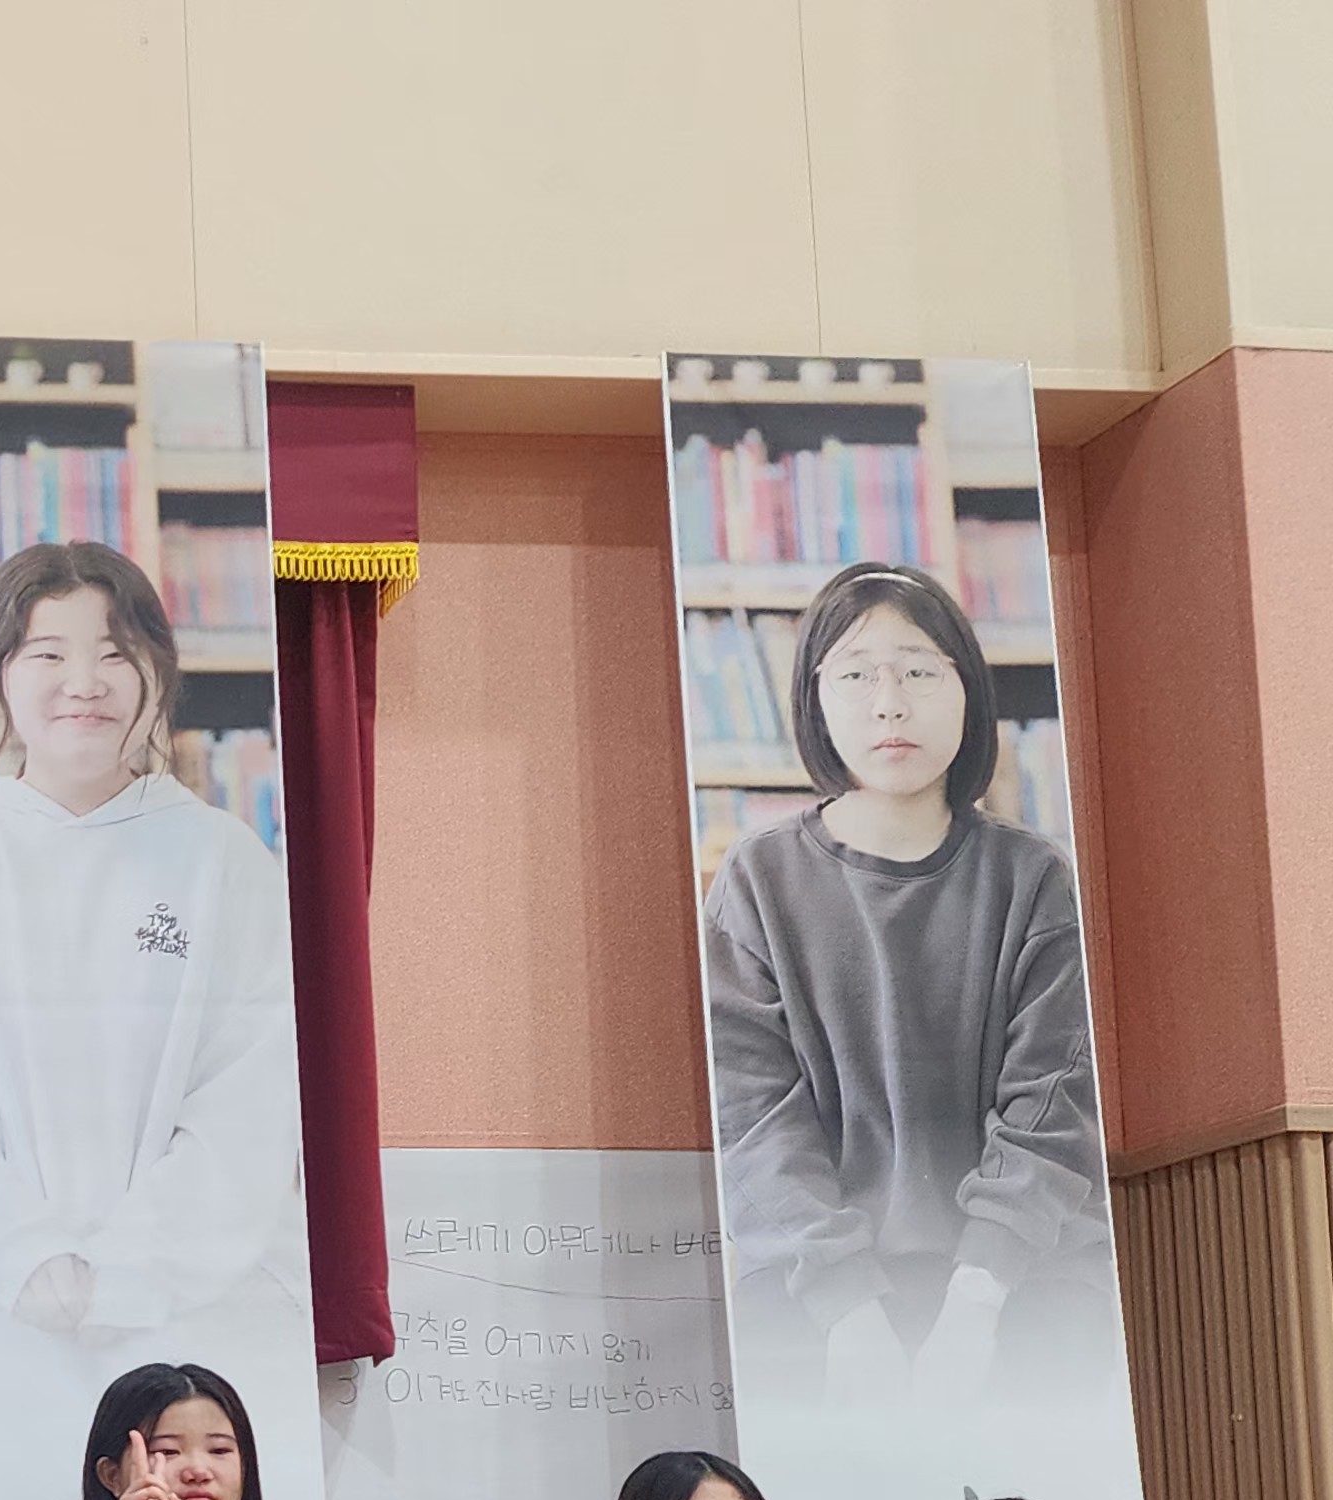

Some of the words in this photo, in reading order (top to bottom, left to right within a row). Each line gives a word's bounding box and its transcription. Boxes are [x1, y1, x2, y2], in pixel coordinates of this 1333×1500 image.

[405, 1218, 509, 1256] 쓰레기
[485, 1325, 590, 1358] 어기지
[569, 1376, 701, 1414] 비난하지
